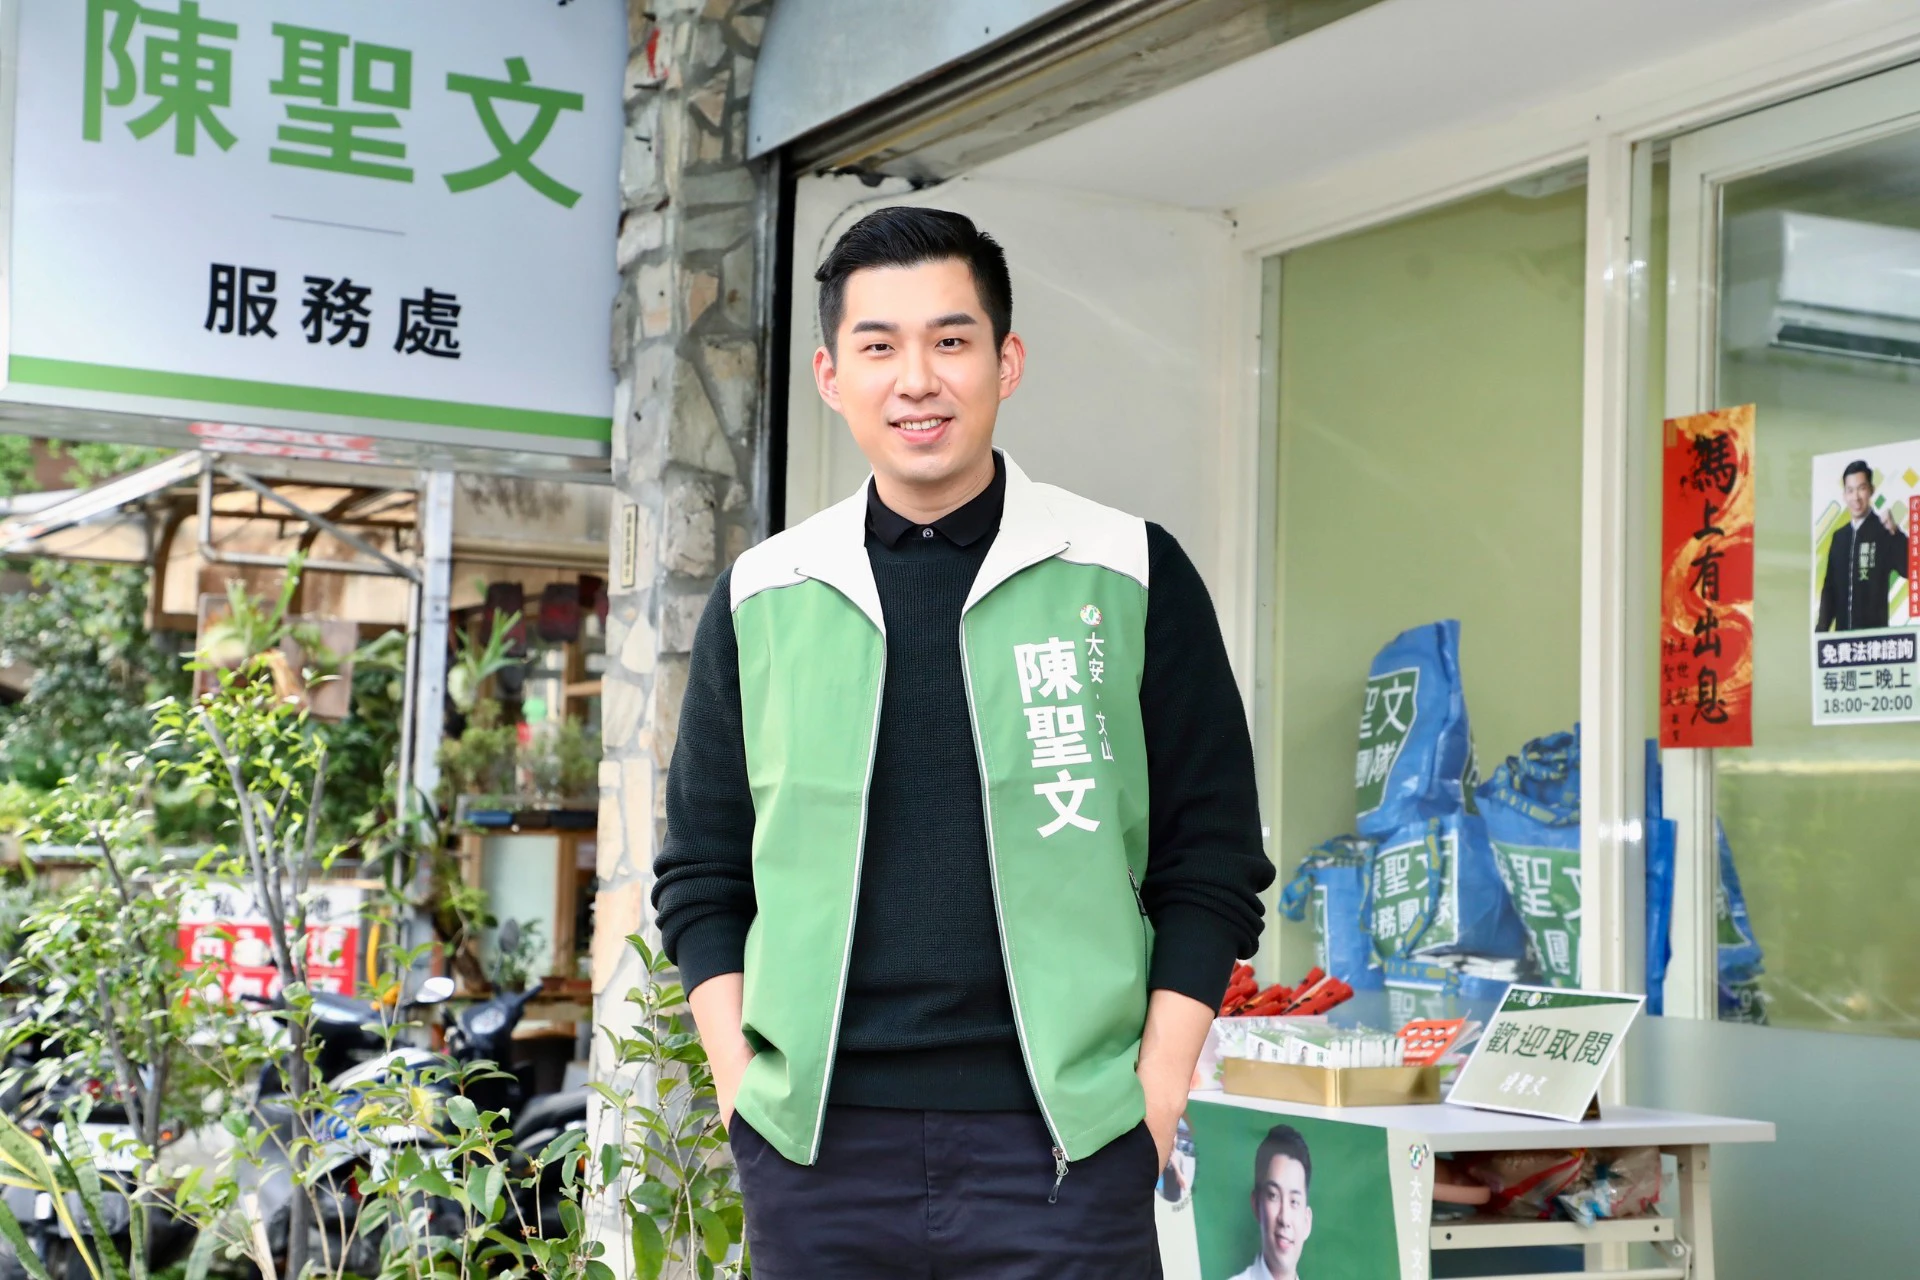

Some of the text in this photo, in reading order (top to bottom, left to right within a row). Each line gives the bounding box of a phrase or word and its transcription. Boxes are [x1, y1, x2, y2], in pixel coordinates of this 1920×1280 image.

[82, 0, 585, 209] 陳聖文
[204, 262, 461, 360] 服務處
[1822, 639, 1914, 664] 免費法律諮詢
[1823, 667, 1912, 692] 每週二晚上
[1823, 695, 1913, 714] 18:00~20:00
[1013, 636, 1101, 838] 陳聖文
[1486, 1021, 1614, 1066] 歡迎取閱
